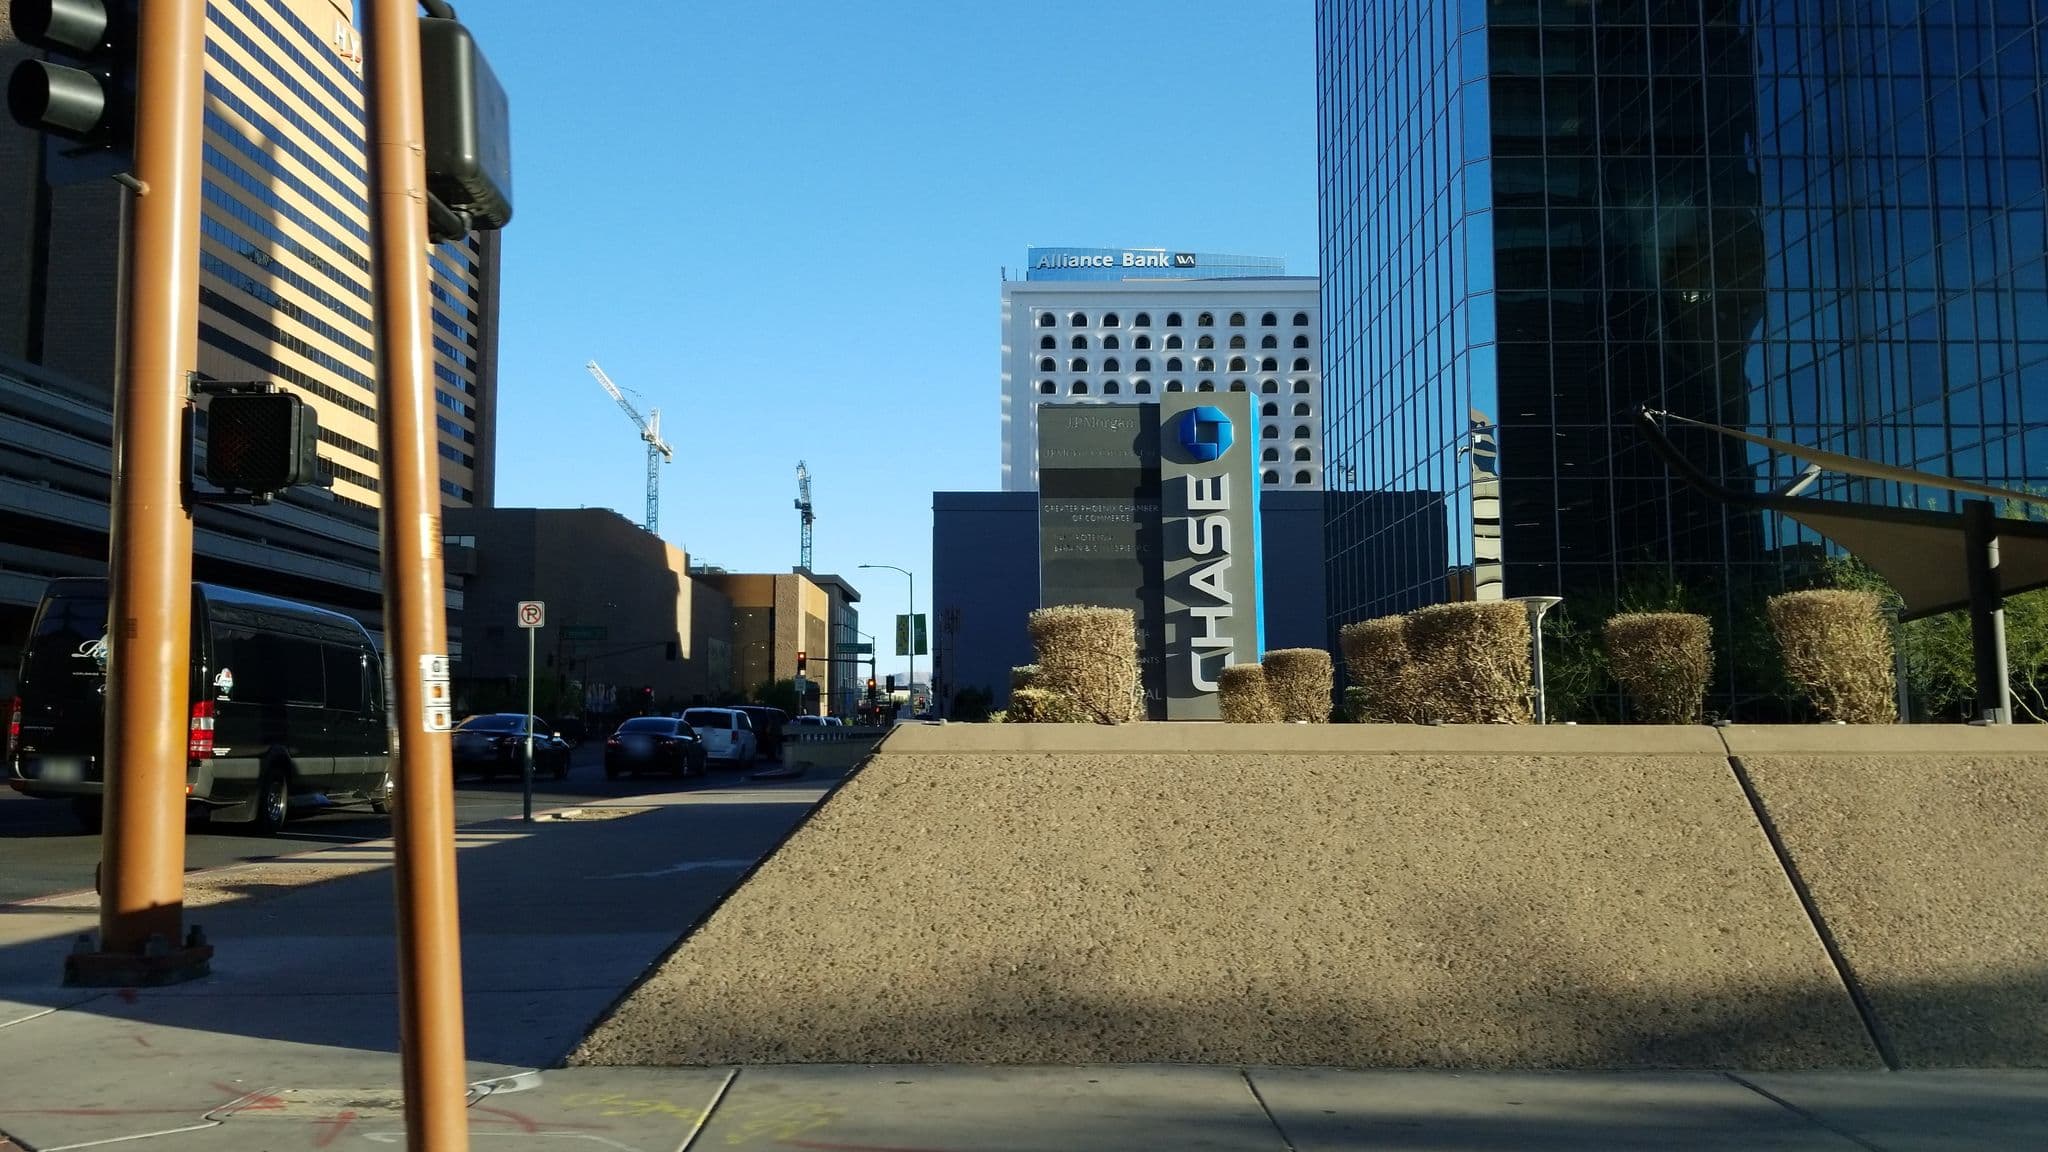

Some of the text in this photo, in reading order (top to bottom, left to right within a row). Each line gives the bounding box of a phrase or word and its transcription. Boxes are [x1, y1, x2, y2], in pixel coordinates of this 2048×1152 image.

[1038, 254, 1114, 269] Alliance
[1122, 253, 1169, 267] Bank
[1187, 472, 1234, 692] CHASE
